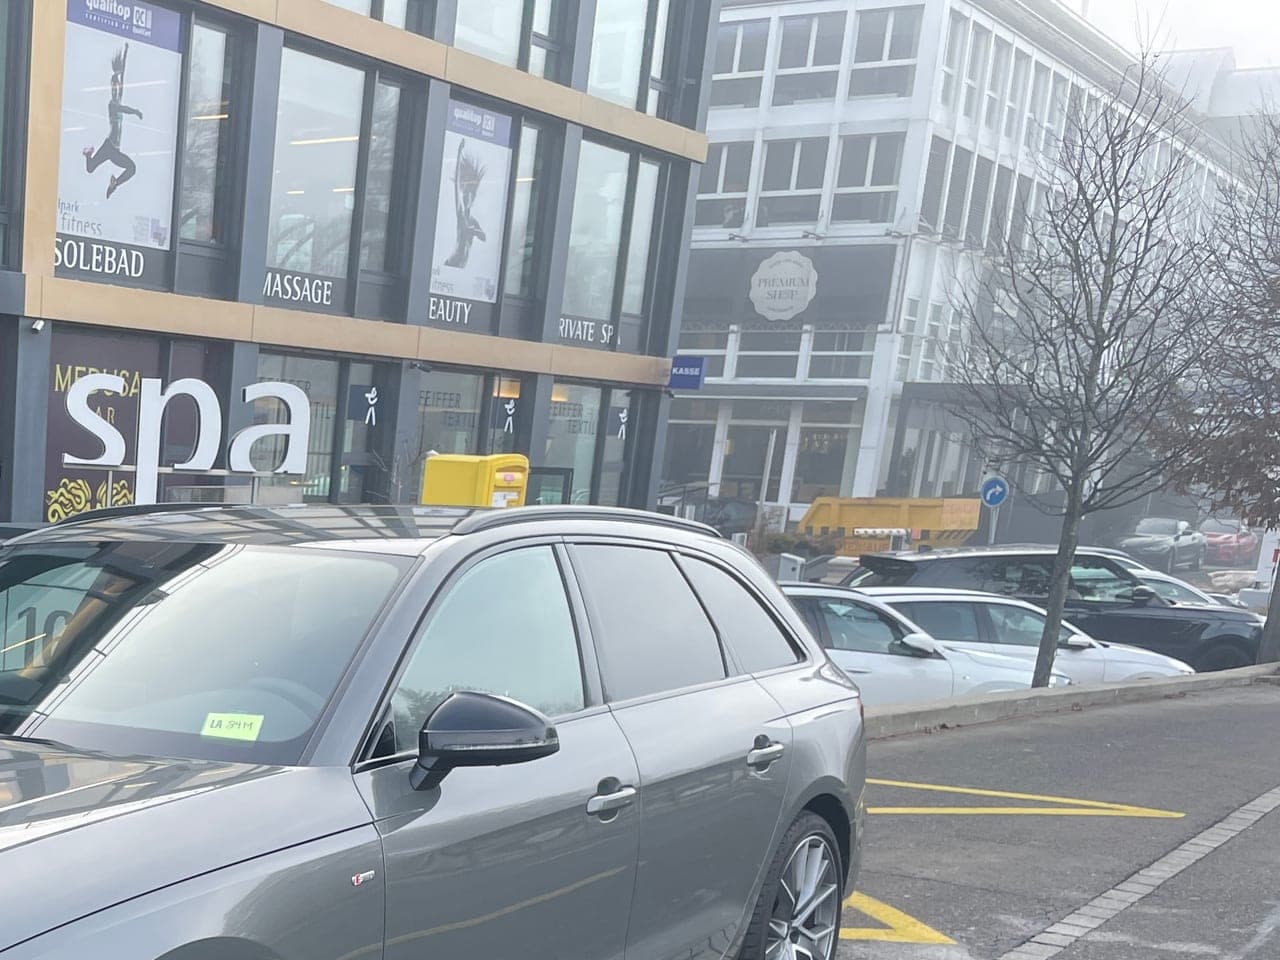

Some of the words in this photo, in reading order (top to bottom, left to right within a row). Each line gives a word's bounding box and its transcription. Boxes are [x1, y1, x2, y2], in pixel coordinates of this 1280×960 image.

[61, 212, 103, 236] fitness
[672, 367, 700, 376] KASSE
[62, 373, 310, 505] spa
